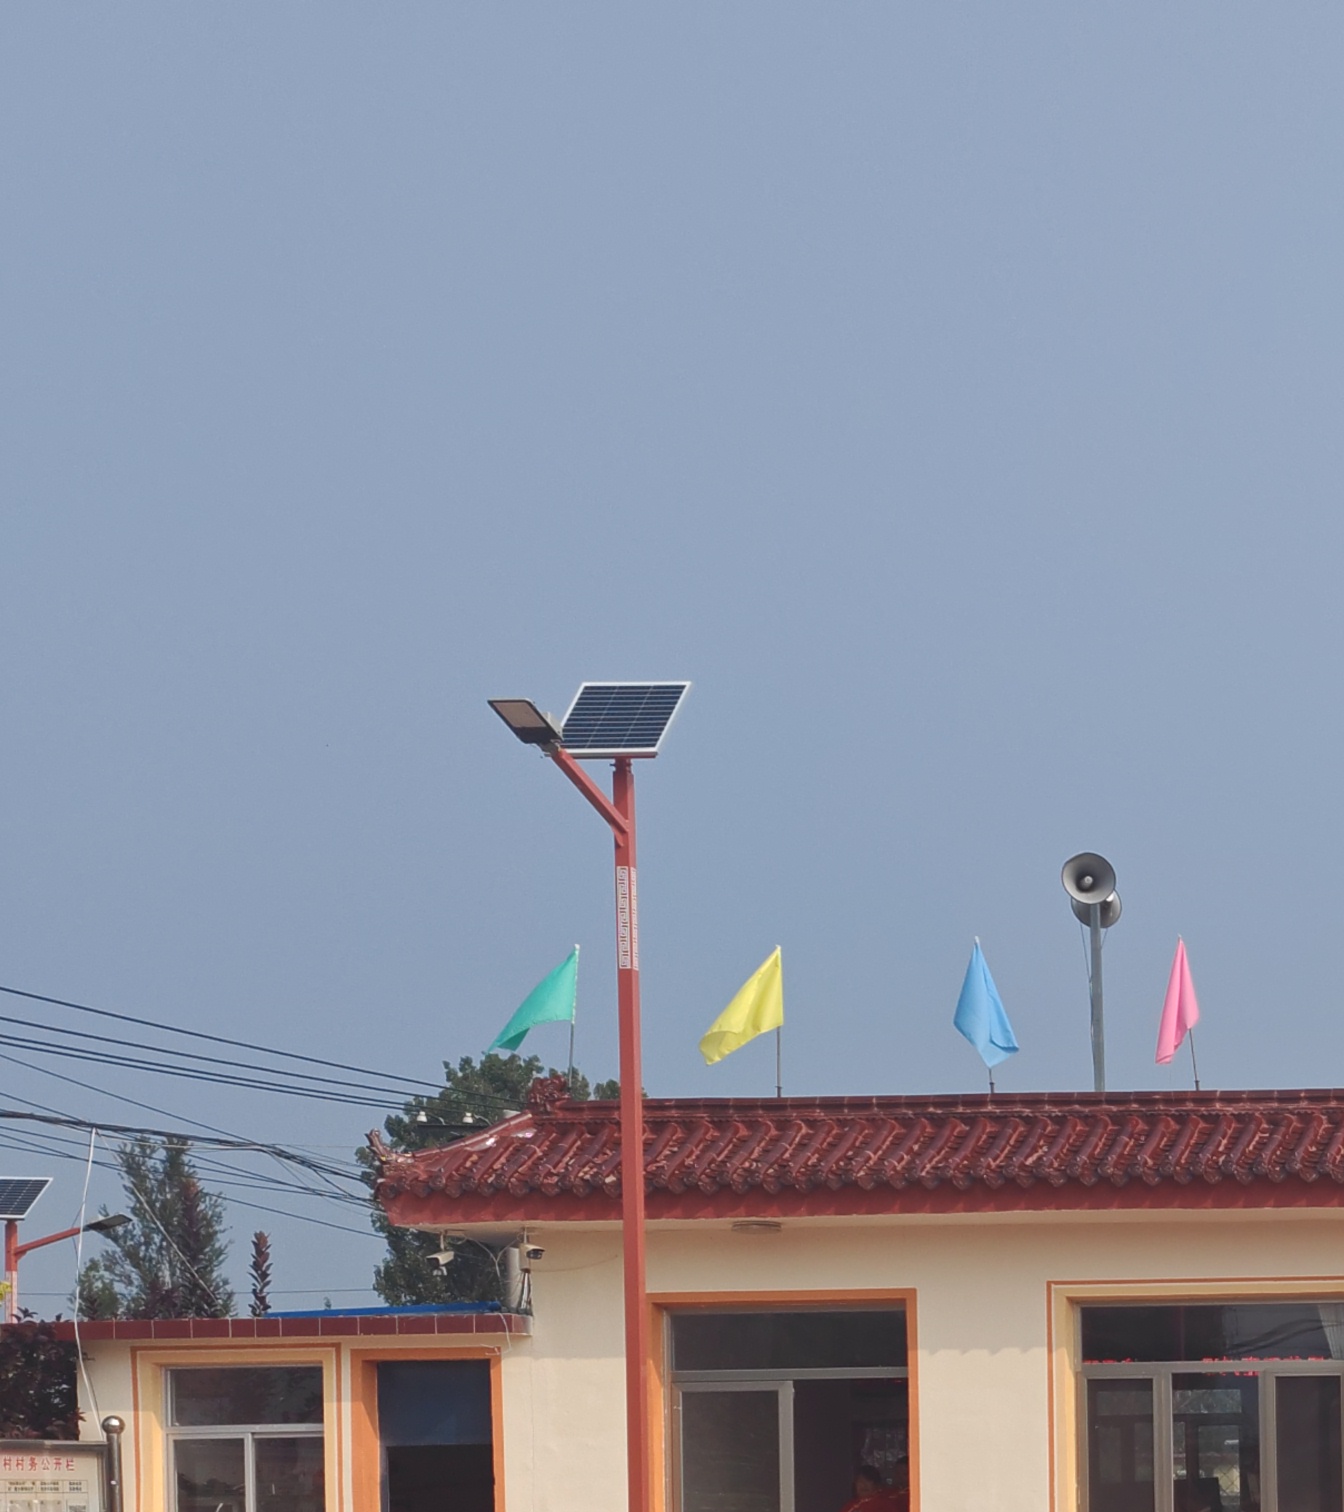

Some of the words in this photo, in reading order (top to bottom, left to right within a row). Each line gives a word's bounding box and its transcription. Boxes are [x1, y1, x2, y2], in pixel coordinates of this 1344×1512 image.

[3, 1457, 75, 1472] 村村务公开栏
